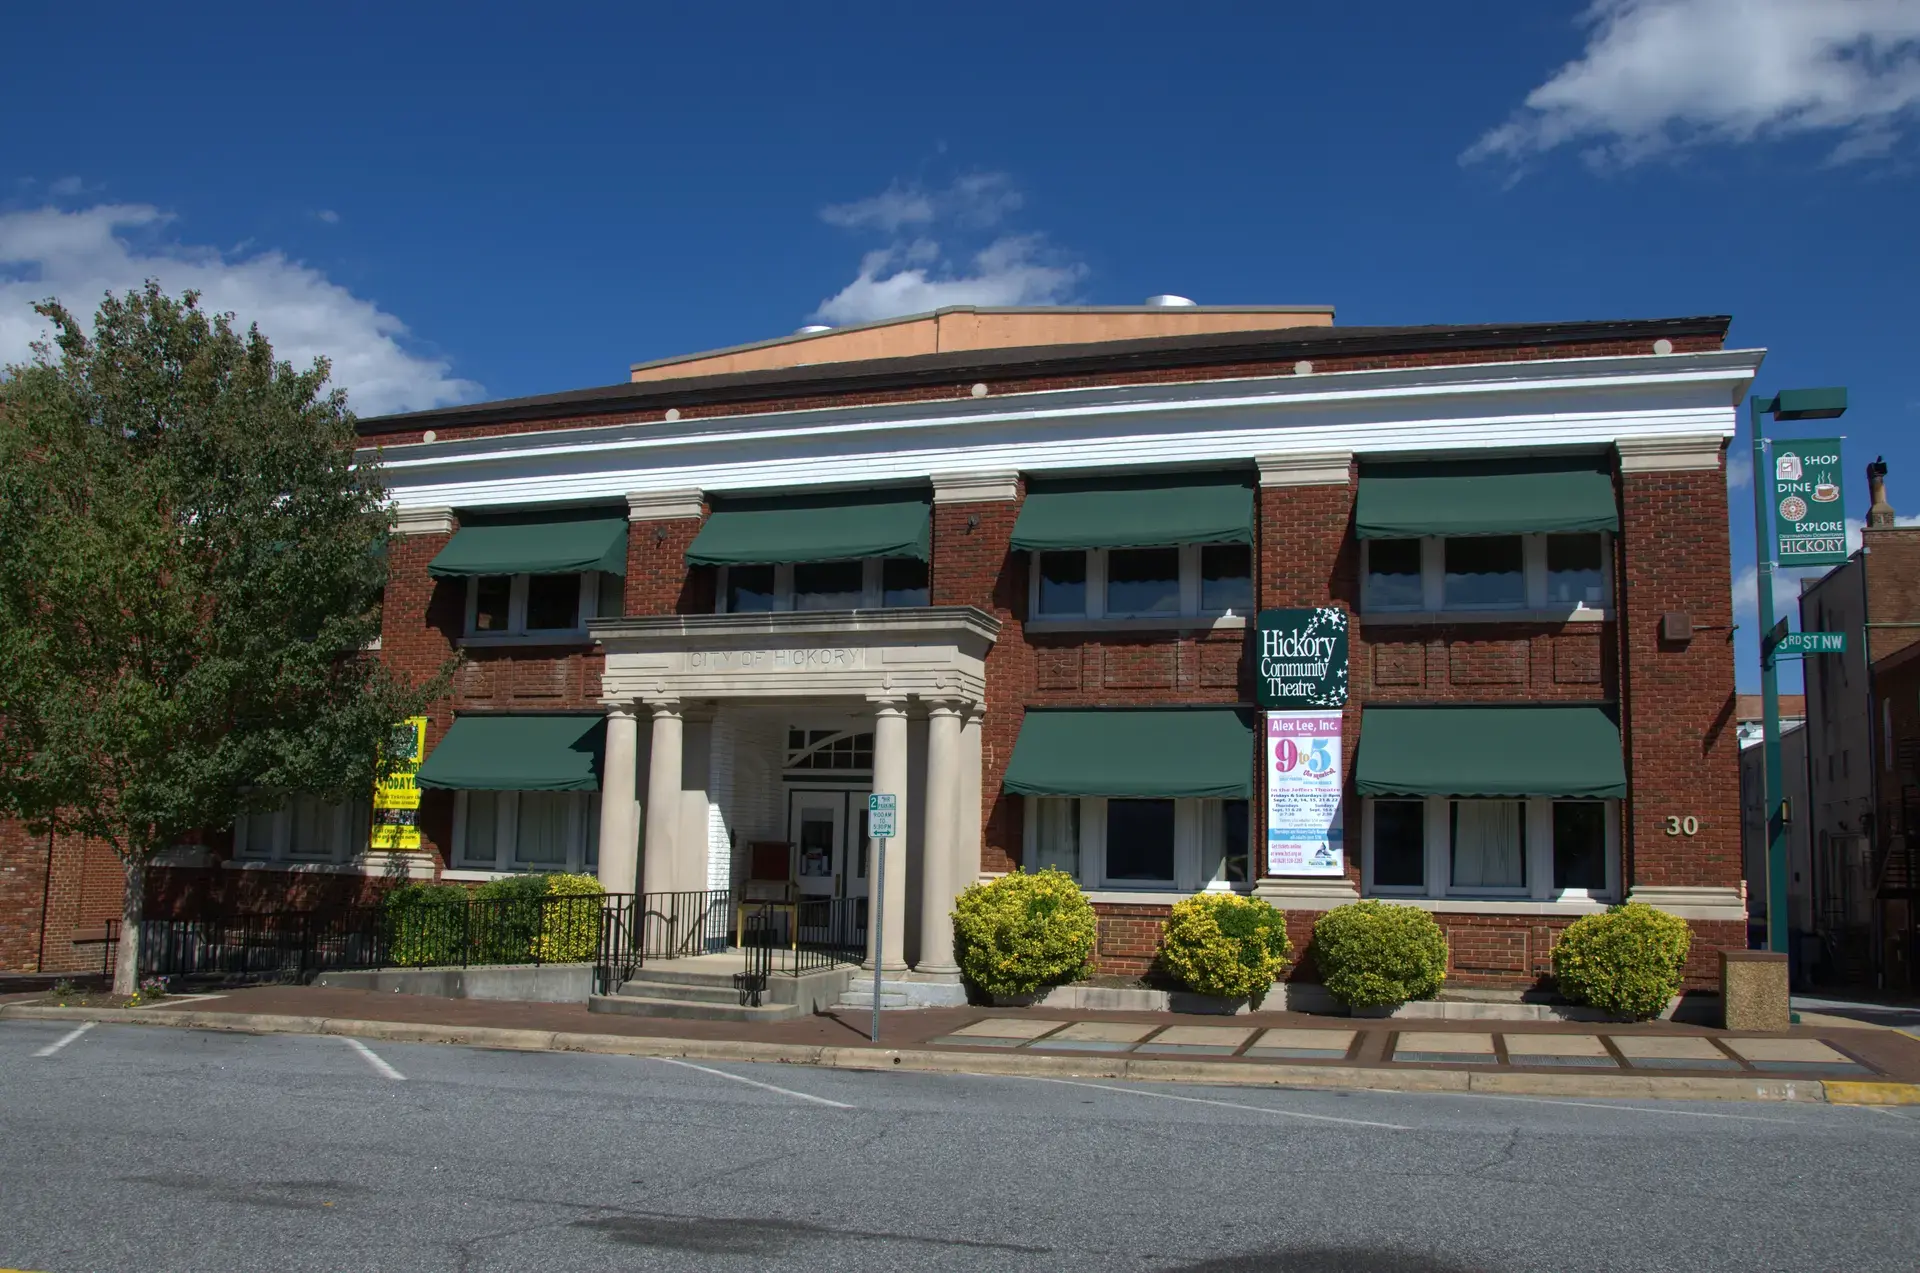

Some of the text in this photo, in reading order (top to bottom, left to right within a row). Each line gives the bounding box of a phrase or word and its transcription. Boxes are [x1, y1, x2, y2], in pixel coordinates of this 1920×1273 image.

[1804, 455, 1838, 465] SHOP
[1777, 482, 1811, 492] DINE
[1795, 521, 1843, 532] EXPLORE
[1780, 539, 1845, 553] HICKORY
[1262, 628, 1337, 663] Hickory
[1803, 635, 1819, 649] ST
[1822, 635, 1842, 649] NW
[691, 649, 859, 667] CITY OF HICKORY
[1261, 657, 1329, 681] Community
[1267, 677, 1316, 697] Theatre
[1272, 719, 1338, 732] Alex Lee, Inc.
[1275, 738, 1331, 773] 9 to 5
[870, 797, 877, 808] 2
[1667, 815, 1699, 835] 30
